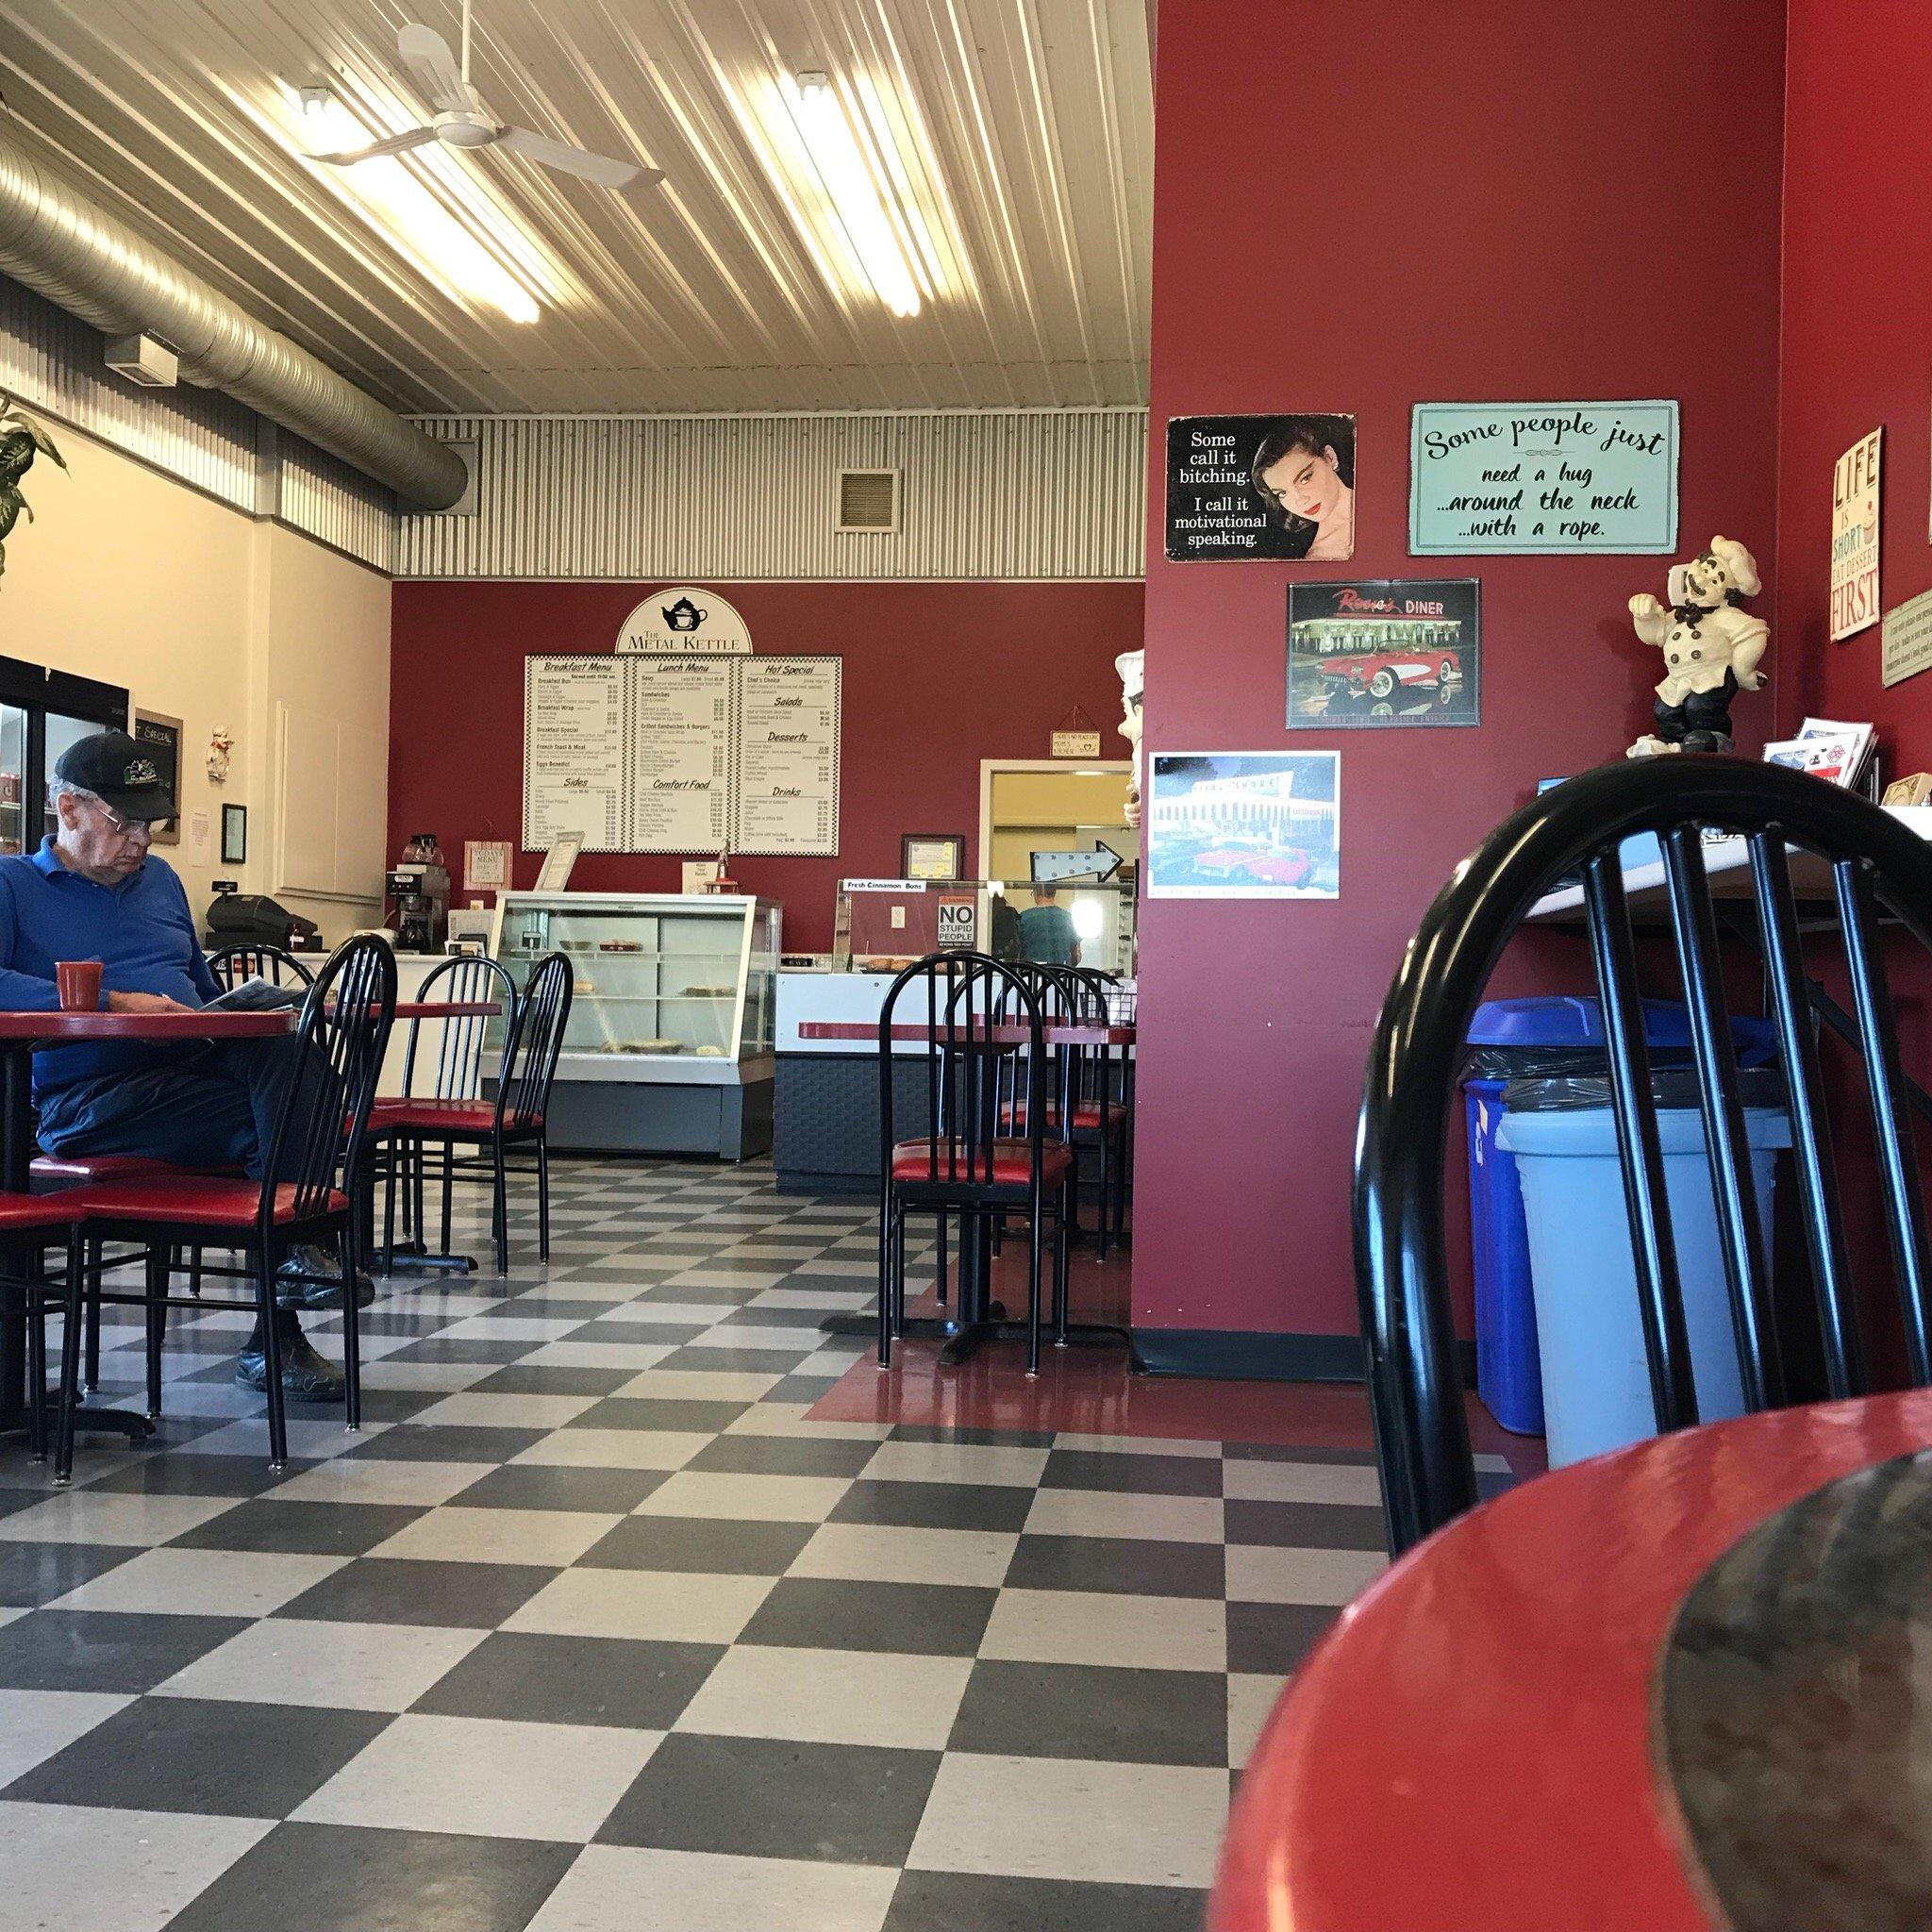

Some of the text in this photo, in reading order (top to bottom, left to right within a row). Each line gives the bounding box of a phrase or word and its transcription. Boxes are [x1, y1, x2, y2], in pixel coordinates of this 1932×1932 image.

[1191, 432, 1236, 447] Some
[1424, 412, 1665, 459] Some people just
[1190, 450, 1237, 465] call it
[1179, 468, 1250, 486] bitching.
[1482, 461, 1592, 489] need a hug
[1836, 436, 1877, 510] LIFE
[1194, 497, 1249, 511] I call it
[1437, 487, 1640, 511] ...around the neck
[1174, 513, 1267, 528] motivational
[1840, 508, 1849, 529] IS
[1458, 514, 1605, 541] ...with a rope.
[1188, 532, 1257, 548] speaking.
[1833, 524, 1862, 562] SHORT
[1833, 545, 1877, 586] EAT DESSERT
[1406, 599, 1444, 615] DINER
[1831, 566, 1877, 635] FIRST
[628, 636, 740, 650] METAL KETTLE
[543, 661, 613, 673] Breakfast Menu
[658, 663, 710, 673] Lunch Menu
[765, 665, 815, 675] Hot Special
[774, 696, 803, 707] Salads
[767, 731, 808, 742] Desserts
[563, 777, 589, 787] Sides
[653, 779, 711, 790] Comfort Food
[772, 787, 802, 797] Drinks
[940, 907, 973, 924] NO
